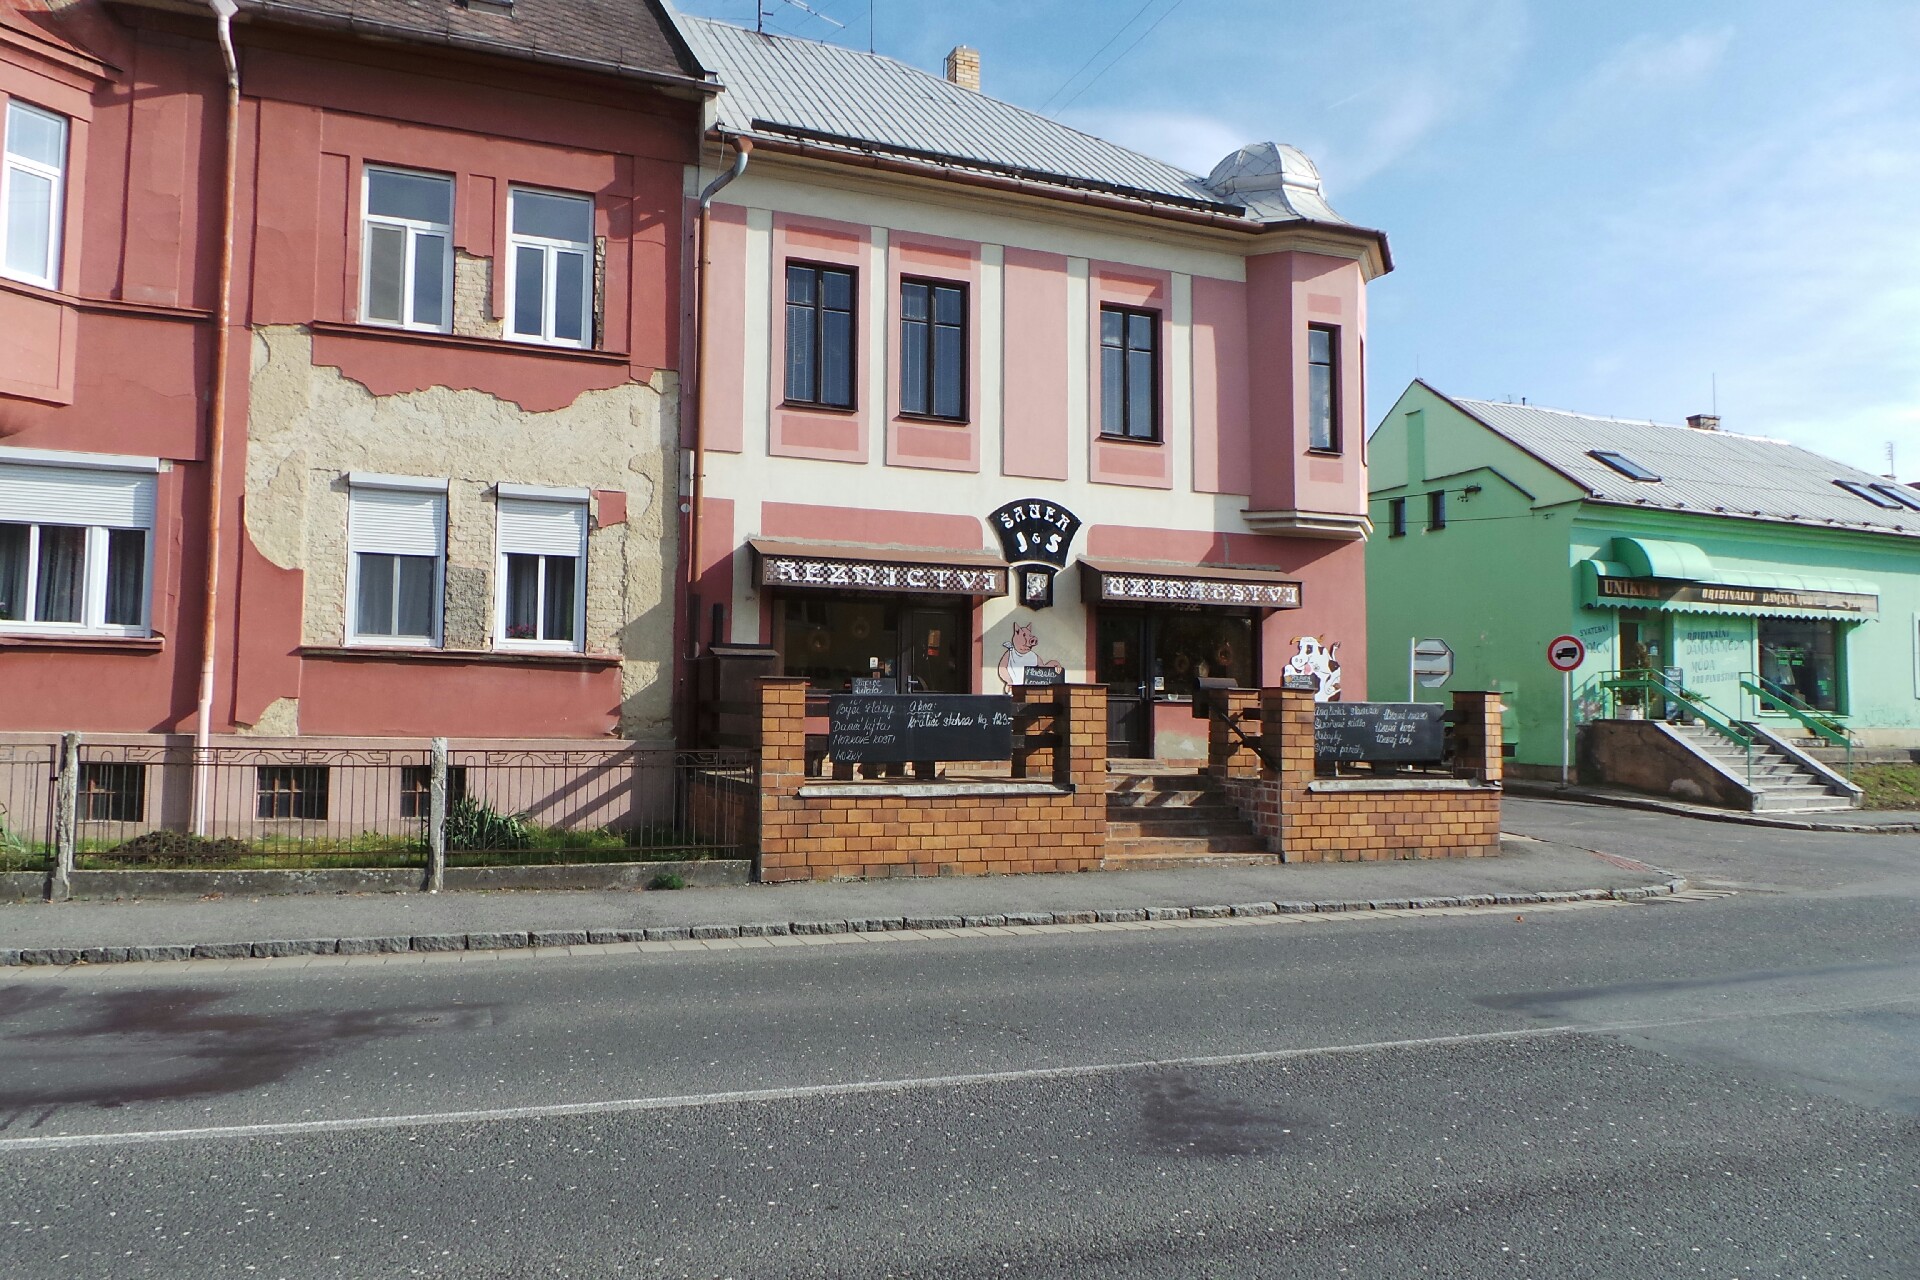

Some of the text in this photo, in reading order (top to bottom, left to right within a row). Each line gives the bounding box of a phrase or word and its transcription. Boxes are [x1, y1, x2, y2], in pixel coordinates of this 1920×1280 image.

[1000, 504, 1070, 532] ŠAUER
[1016, 531, 1063, 553] J & S
